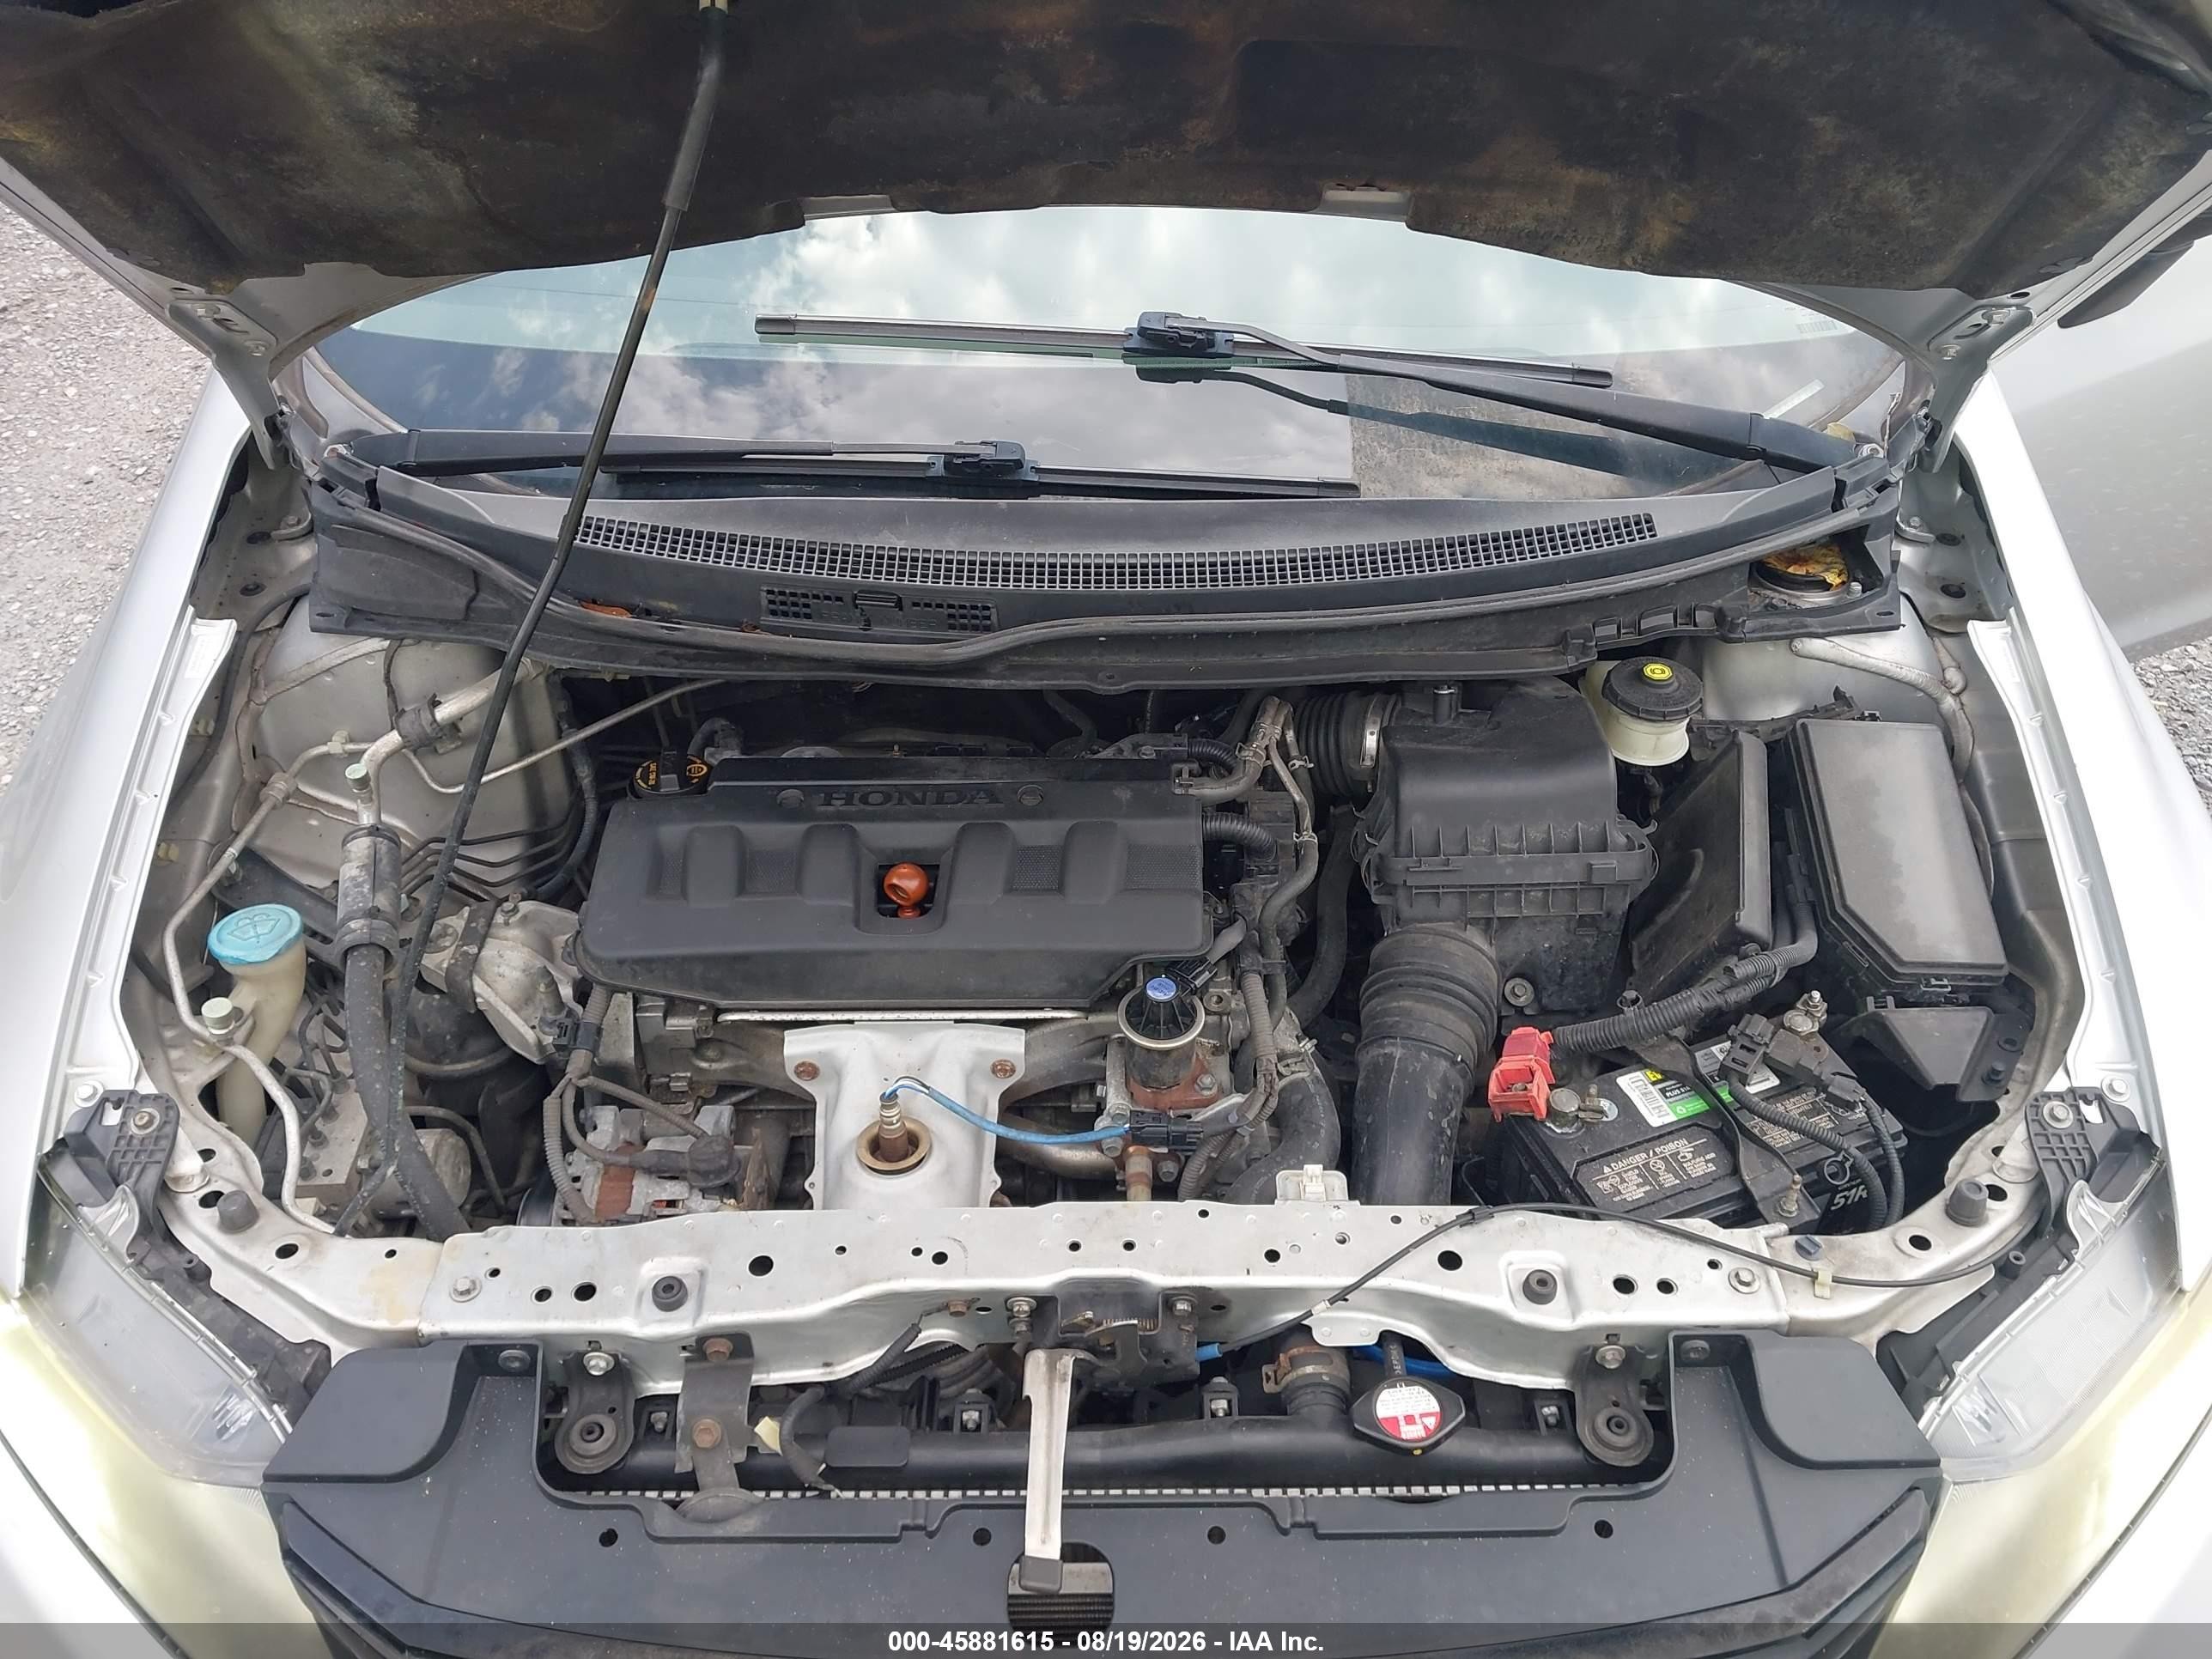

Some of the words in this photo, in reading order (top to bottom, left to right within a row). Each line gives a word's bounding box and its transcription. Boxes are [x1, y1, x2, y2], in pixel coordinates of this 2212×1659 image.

[817, 790, 1004, 807] HONDA
[1610, 1152, 1649, 1170] DANGER
[1654, 1138, 1689, 1155] POISON
